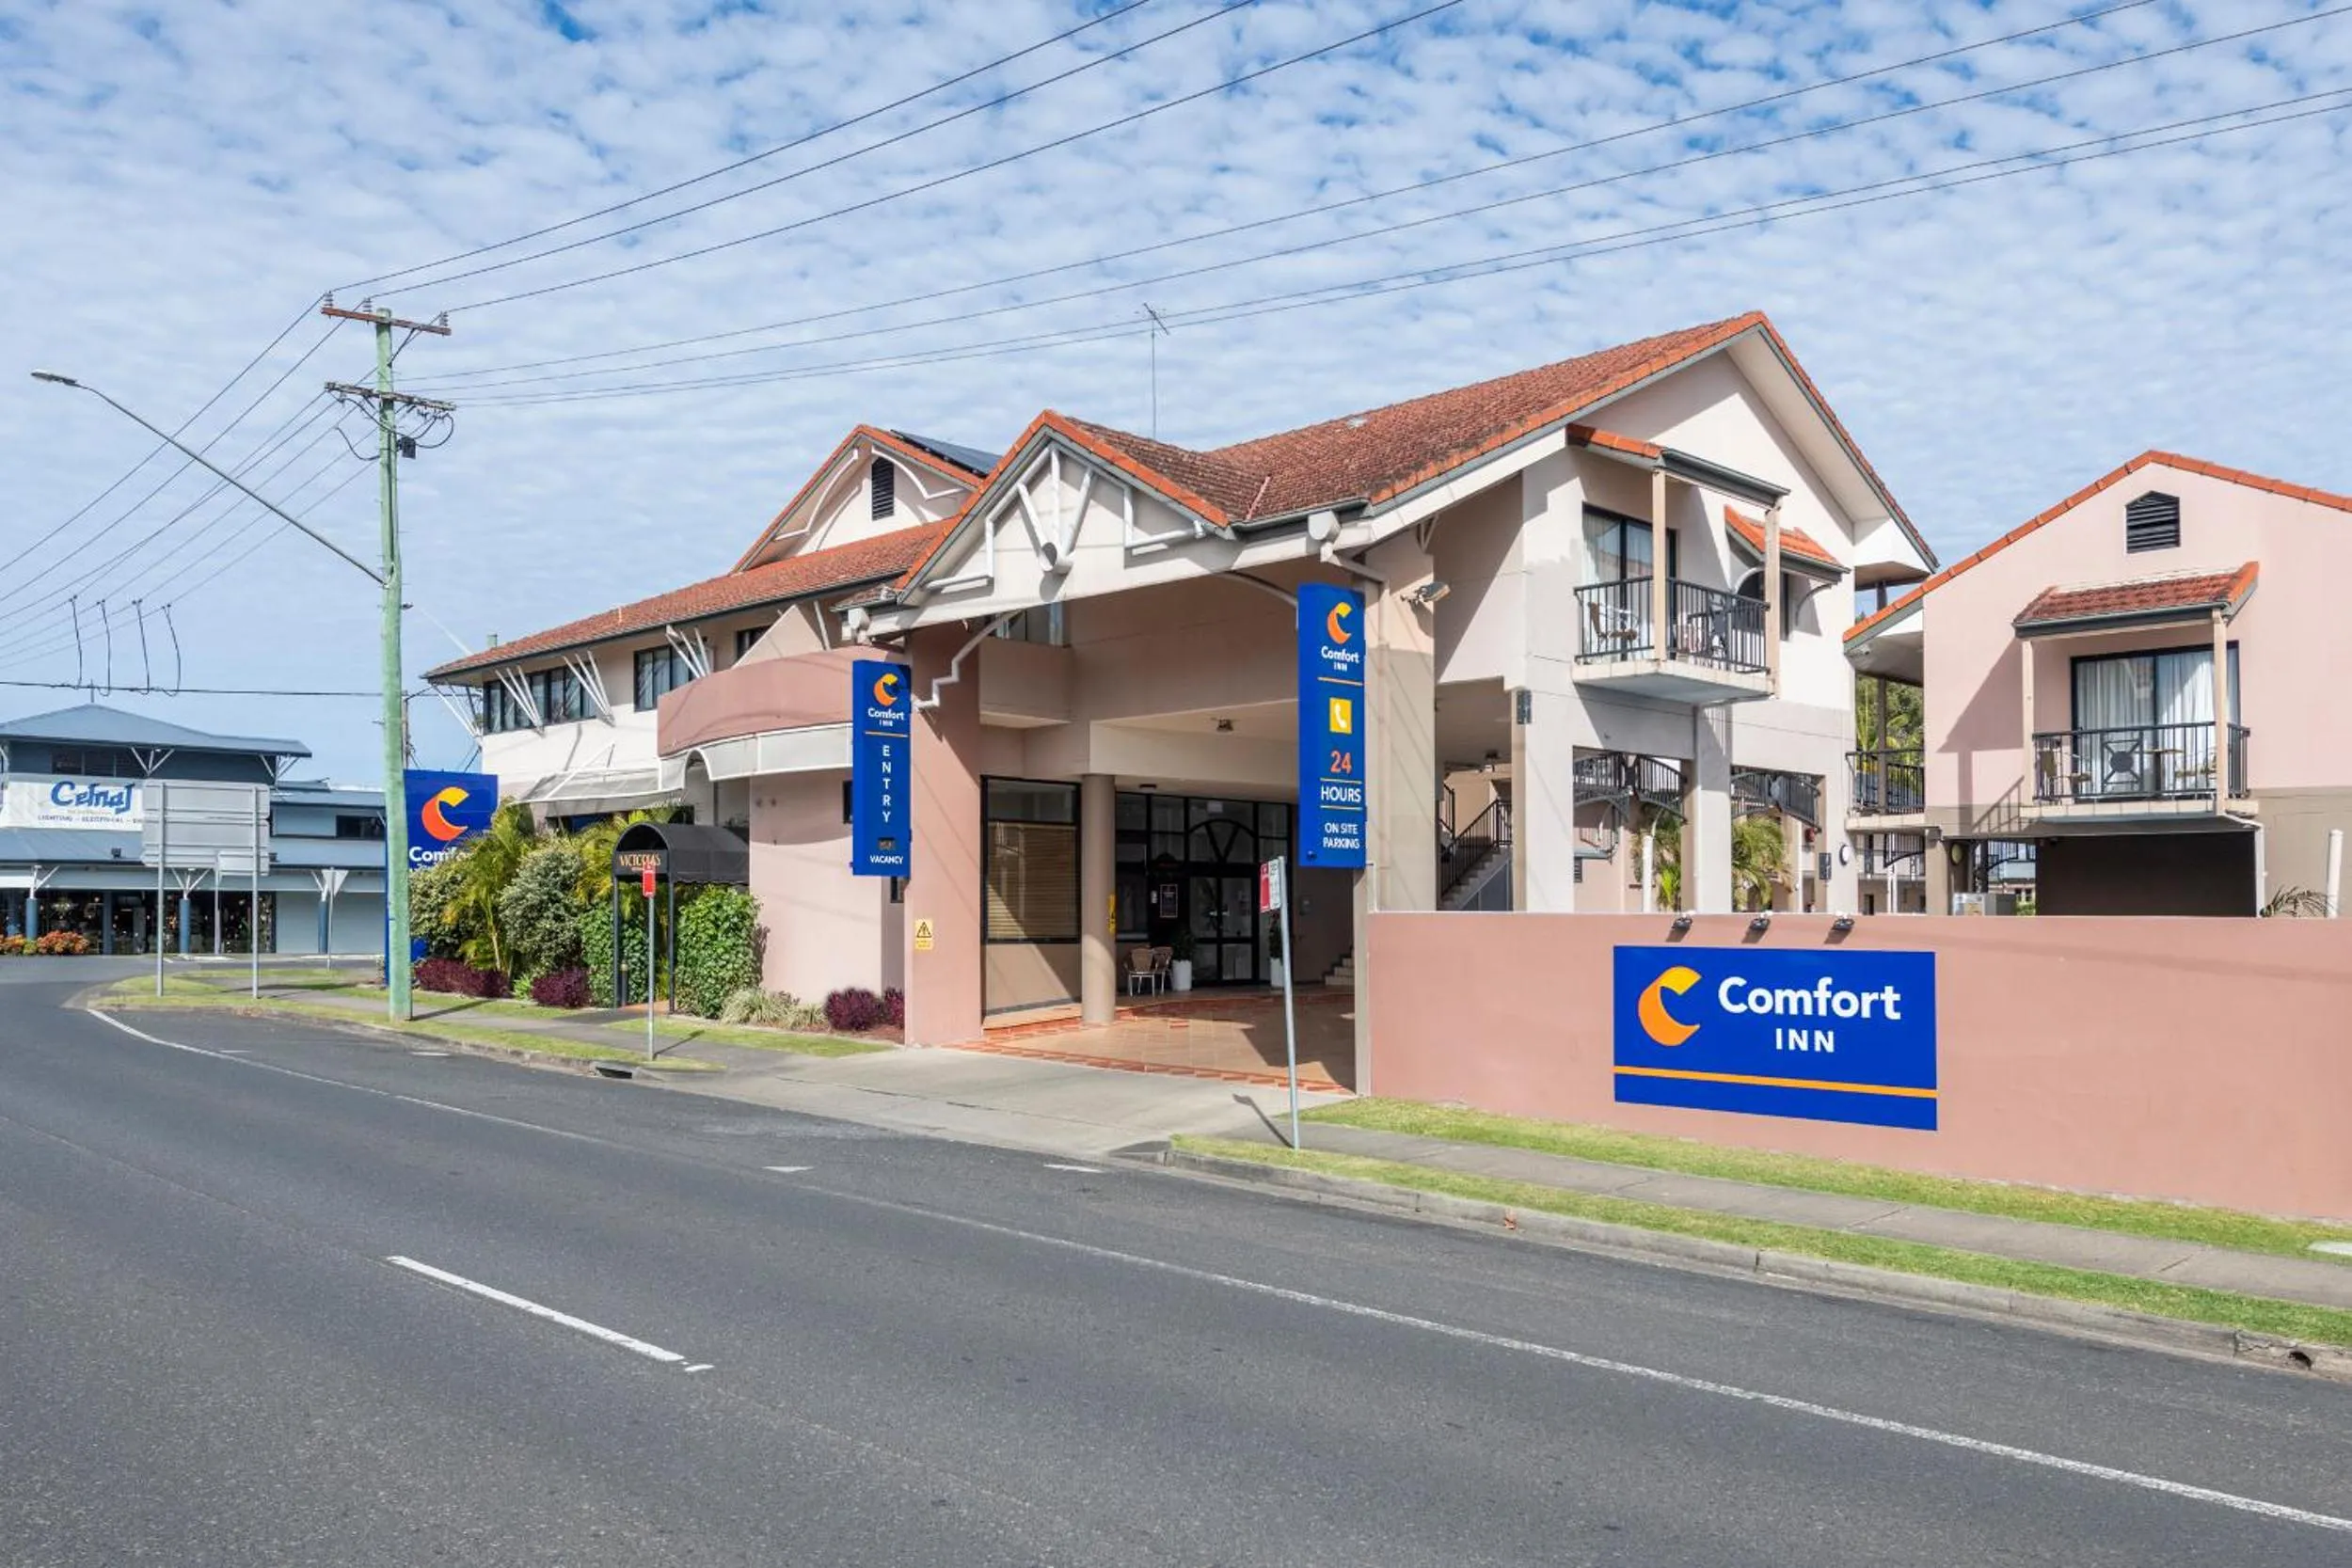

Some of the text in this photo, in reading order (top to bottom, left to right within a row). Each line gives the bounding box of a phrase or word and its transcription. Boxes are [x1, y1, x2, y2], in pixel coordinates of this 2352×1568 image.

[1320, 645, 1359, 664] Comfort
[1333, 661, 1348, 672] INN
[867, 707, 904, 721] Comfort
[1330, 751, 1352, 774] 24
[882, 745, 892, 823] ENTRY
[1321, 785, 1361, 802] HOURS
[1324, 822, 1359, 834] ON SITE
[1323, 837, 1360, 849] PARKING
[869, 855, 903, 865] VACANCY
[1718, 976, 1901, 1020] Comfort
[1775, 1028, 1834, 1053] INN
